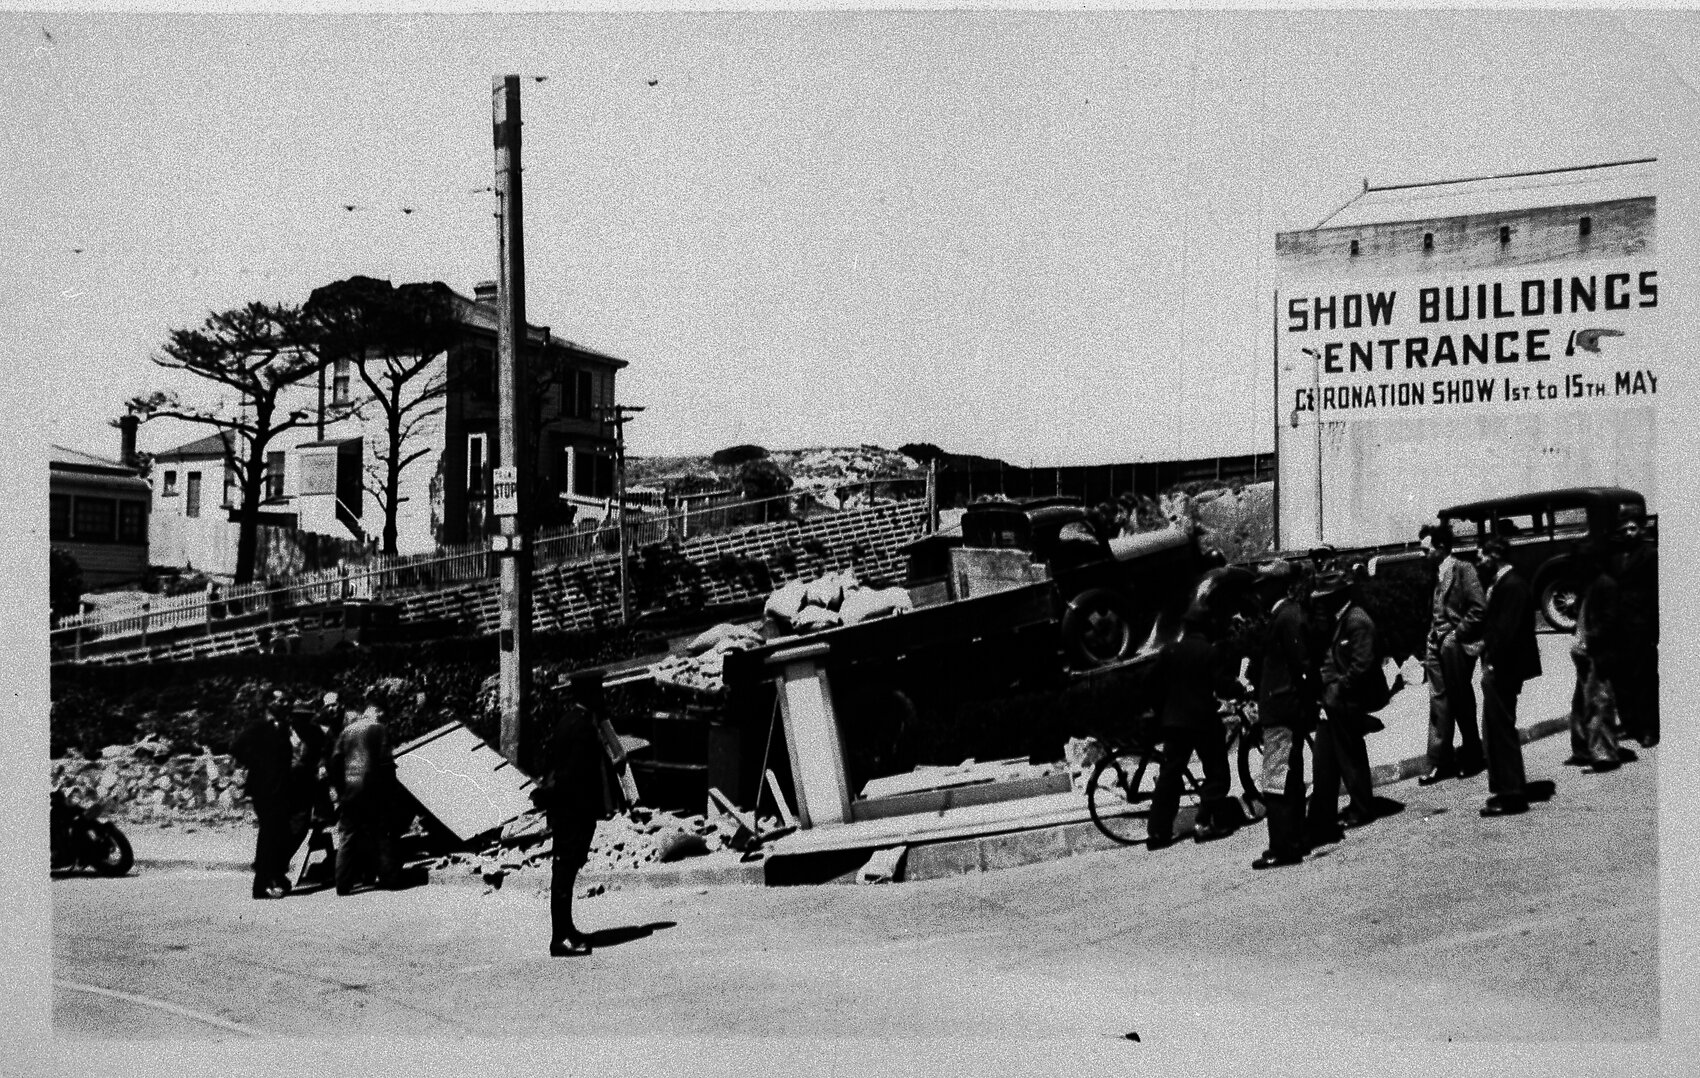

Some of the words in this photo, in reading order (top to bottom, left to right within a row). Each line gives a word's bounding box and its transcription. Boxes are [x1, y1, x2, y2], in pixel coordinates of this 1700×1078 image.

[1288, 291, 1397, 333] SHOW
[1419, 270, 1658, 324] BUILDINGS
[1324, 328, 1551, 374] ENTRANCE
[1432, 378, 1495, 405] SHOW
[1615, 370, 1658, 396] MAY
[493, 482, 517, 499] STOP
